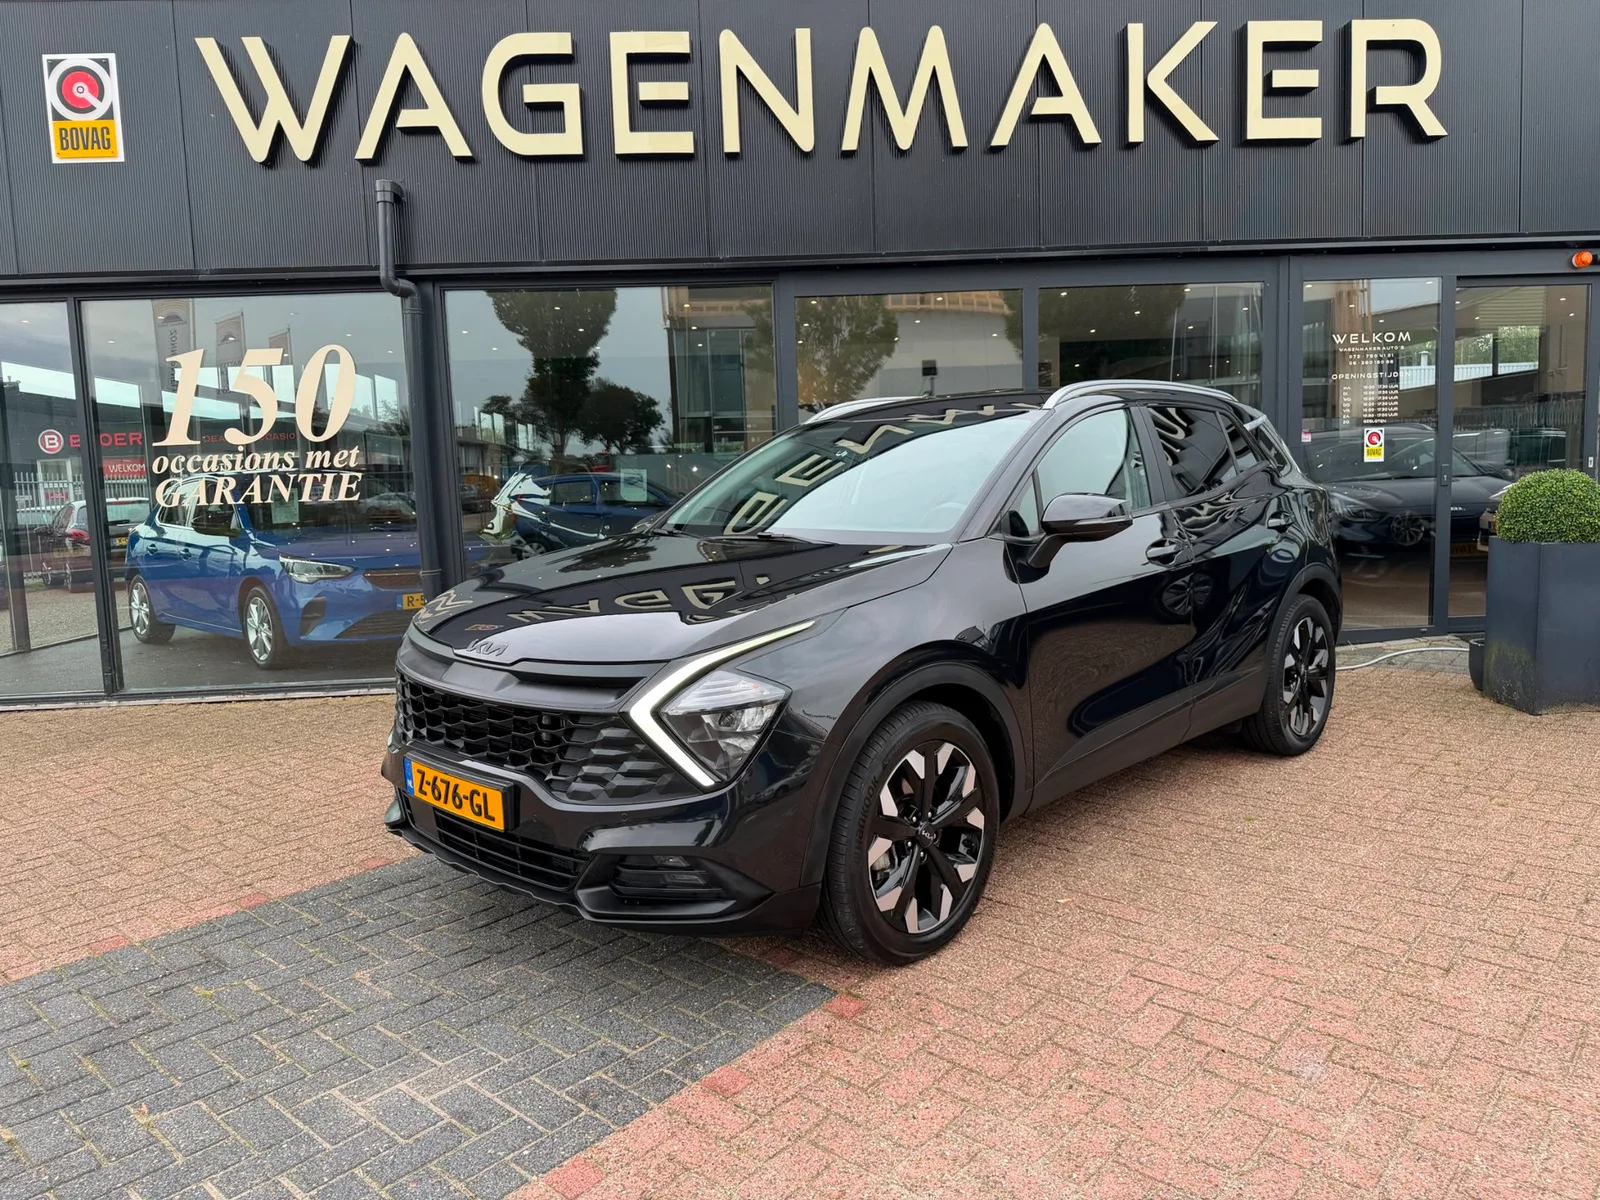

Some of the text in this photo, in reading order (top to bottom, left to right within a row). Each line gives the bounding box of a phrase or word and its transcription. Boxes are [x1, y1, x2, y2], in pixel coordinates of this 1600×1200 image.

[195, 19, 1448, 164] WAGENMAKER
[59, 126, 111, 152] BOVAG
[1332, 331, 1411, 345] WELKOM
[1331, 371, 1411, 380] OPENINGSTIJDEN
[151, 344, 357, 447] 150
[109, 463, 146, 473] WELKOM
[152, 445, 360, 475] occasions met
[155, 472, 363, 508] GARANTIE
[466, 639, 509, 657] KIA
[417, 769, 495, 822] Z-676-GL
